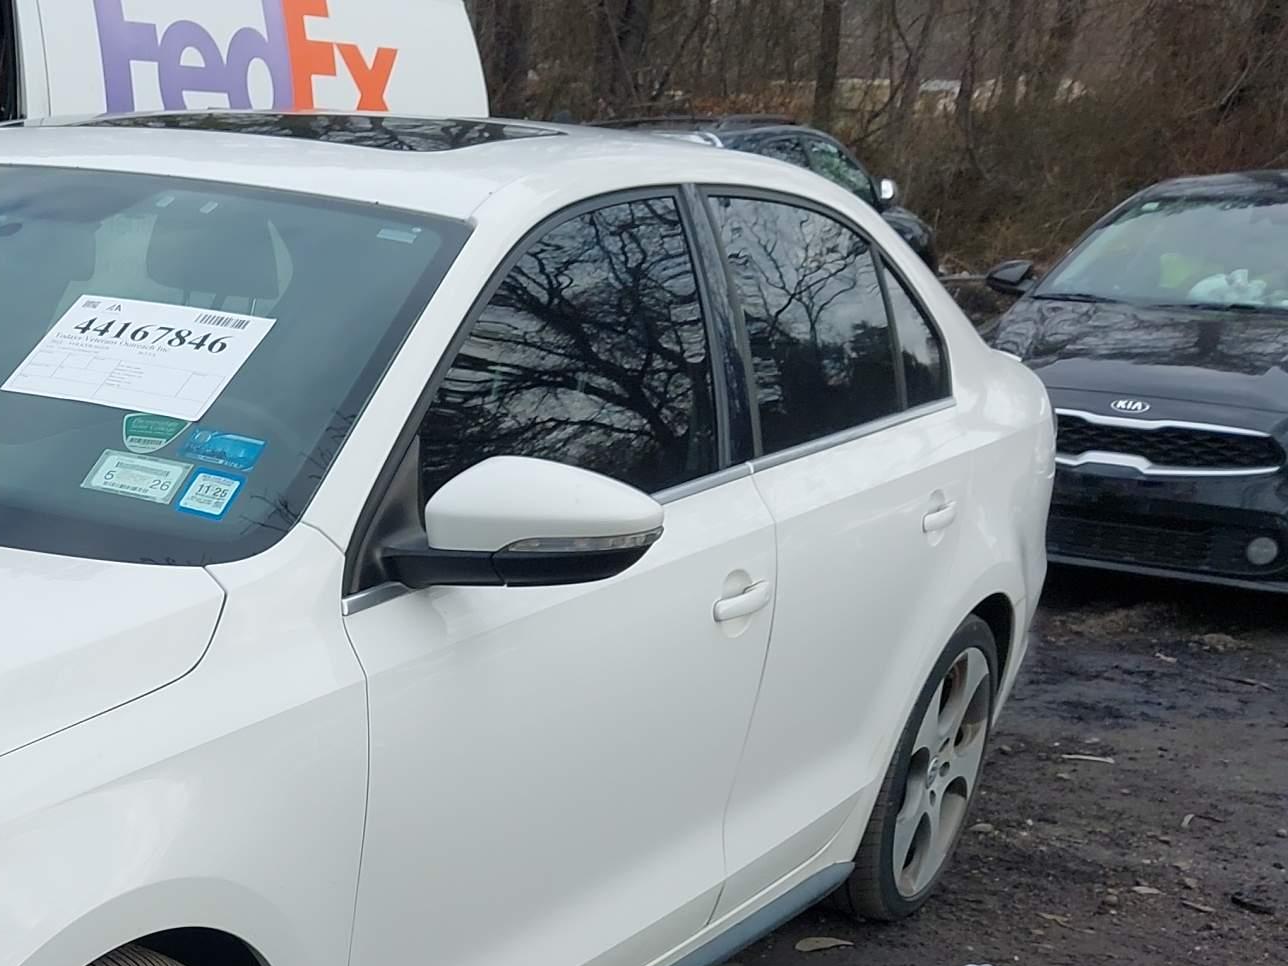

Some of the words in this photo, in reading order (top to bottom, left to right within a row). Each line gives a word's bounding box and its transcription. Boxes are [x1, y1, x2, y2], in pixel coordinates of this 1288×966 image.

[93, 0, 398, 112] FedEx
[73, 316, 233, 353] 44167846
[1116, 400, 1143, 410] KIA
[149, 479, 172, 491] 26
